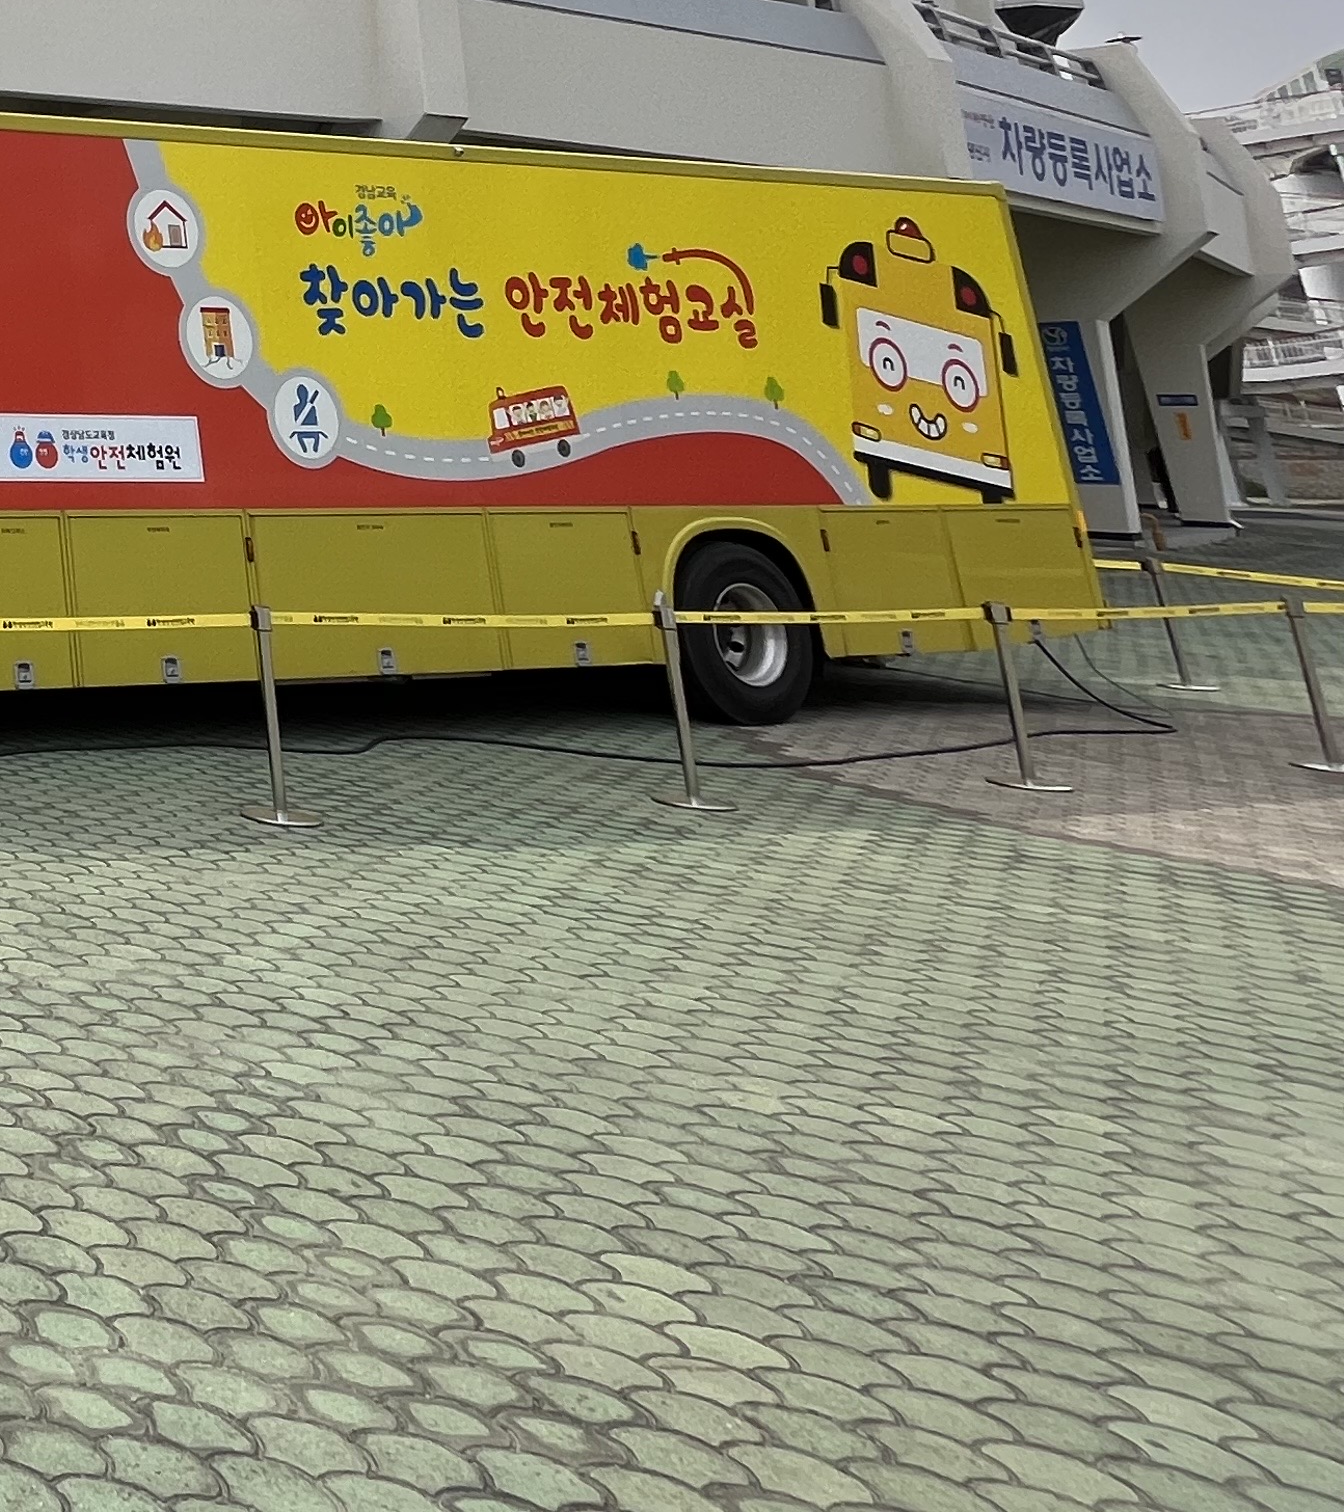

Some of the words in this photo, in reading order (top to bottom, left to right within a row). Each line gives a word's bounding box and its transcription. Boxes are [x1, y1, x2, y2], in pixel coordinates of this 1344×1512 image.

[998, 116, 1156, 202] 차량등록사업소
[355, 184, 397, 200] 경남교육
[294, 200, 423, 257] 아이좋아
[299, 262, 485, 339] 찾아가는
[504, 266, 760, 351] 안전체험교실
[63, 442, 182, 470] 학생안전체험원
